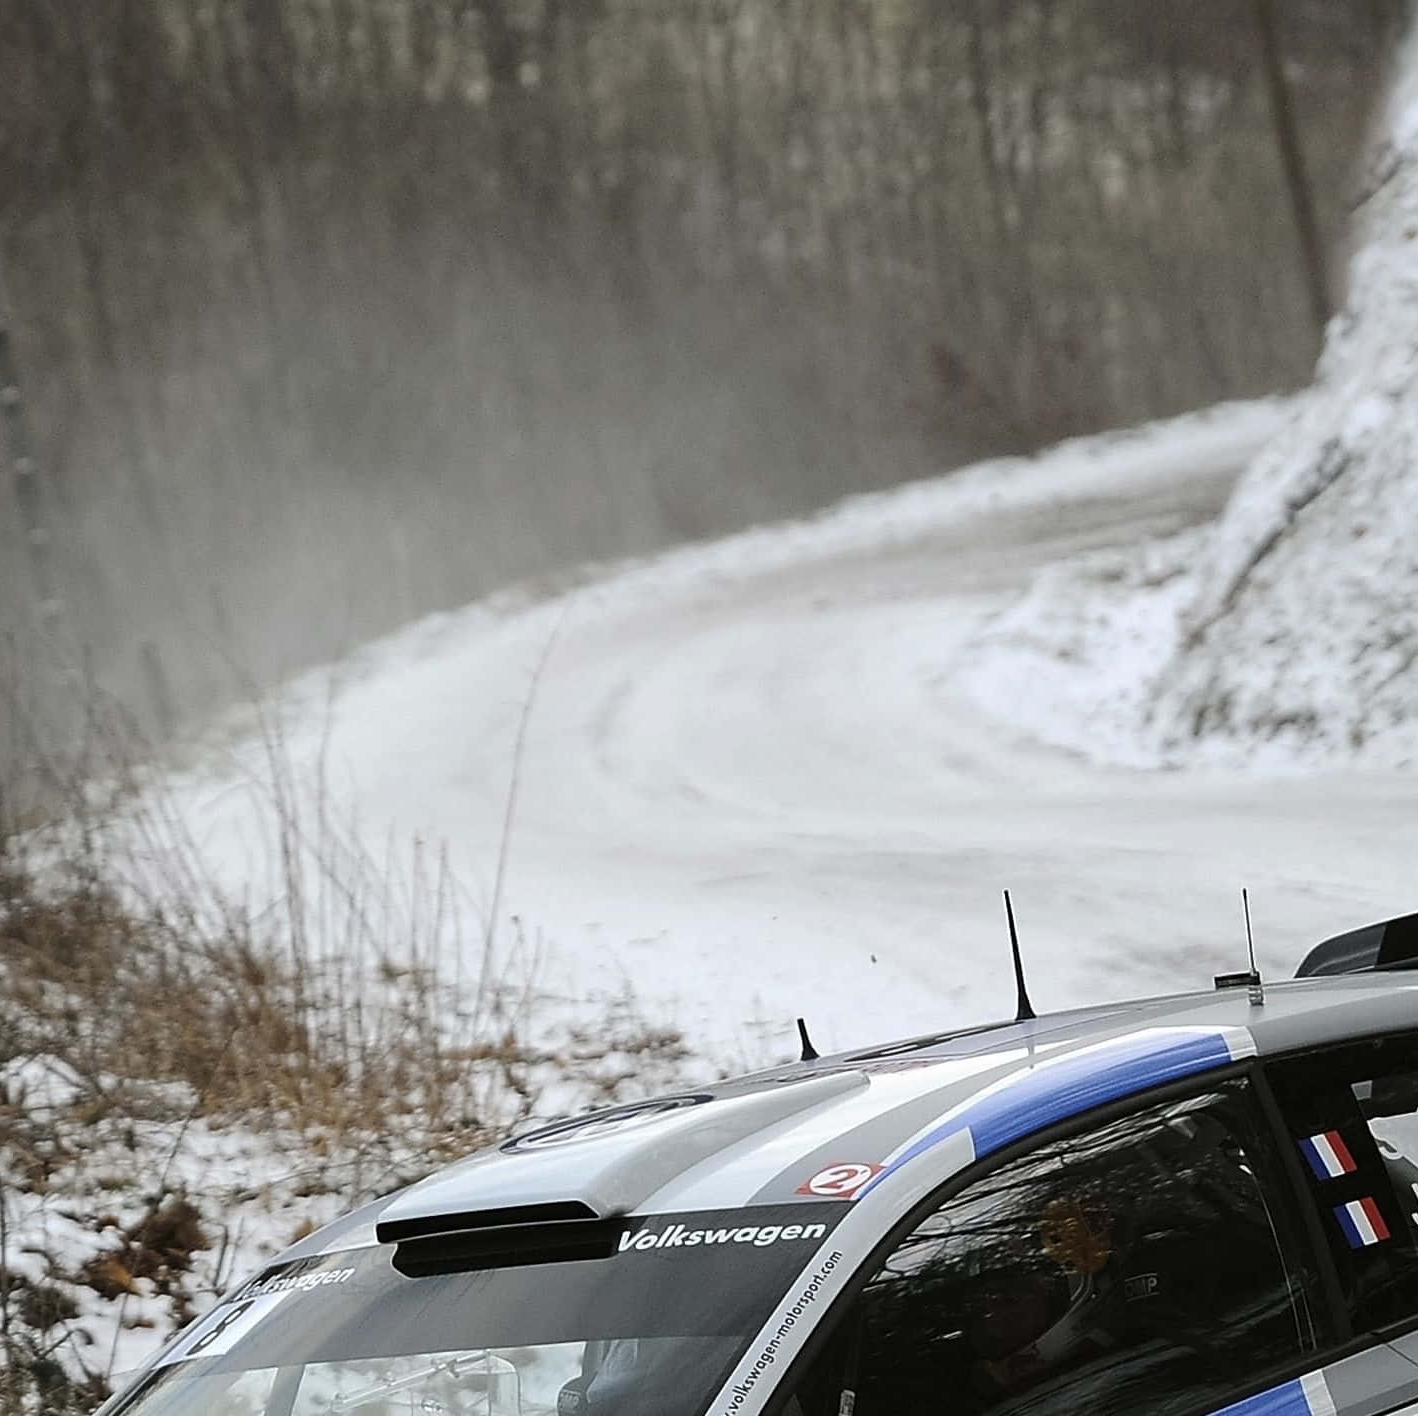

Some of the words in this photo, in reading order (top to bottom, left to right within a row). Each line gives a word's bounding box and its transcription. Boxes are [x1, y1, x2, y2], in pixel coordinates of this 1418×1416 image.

[813, 1168, 859, 1190] 2
[617, 1223, 828, 1252] Volkswagen
[185, 1299, 256, 1356] 8
